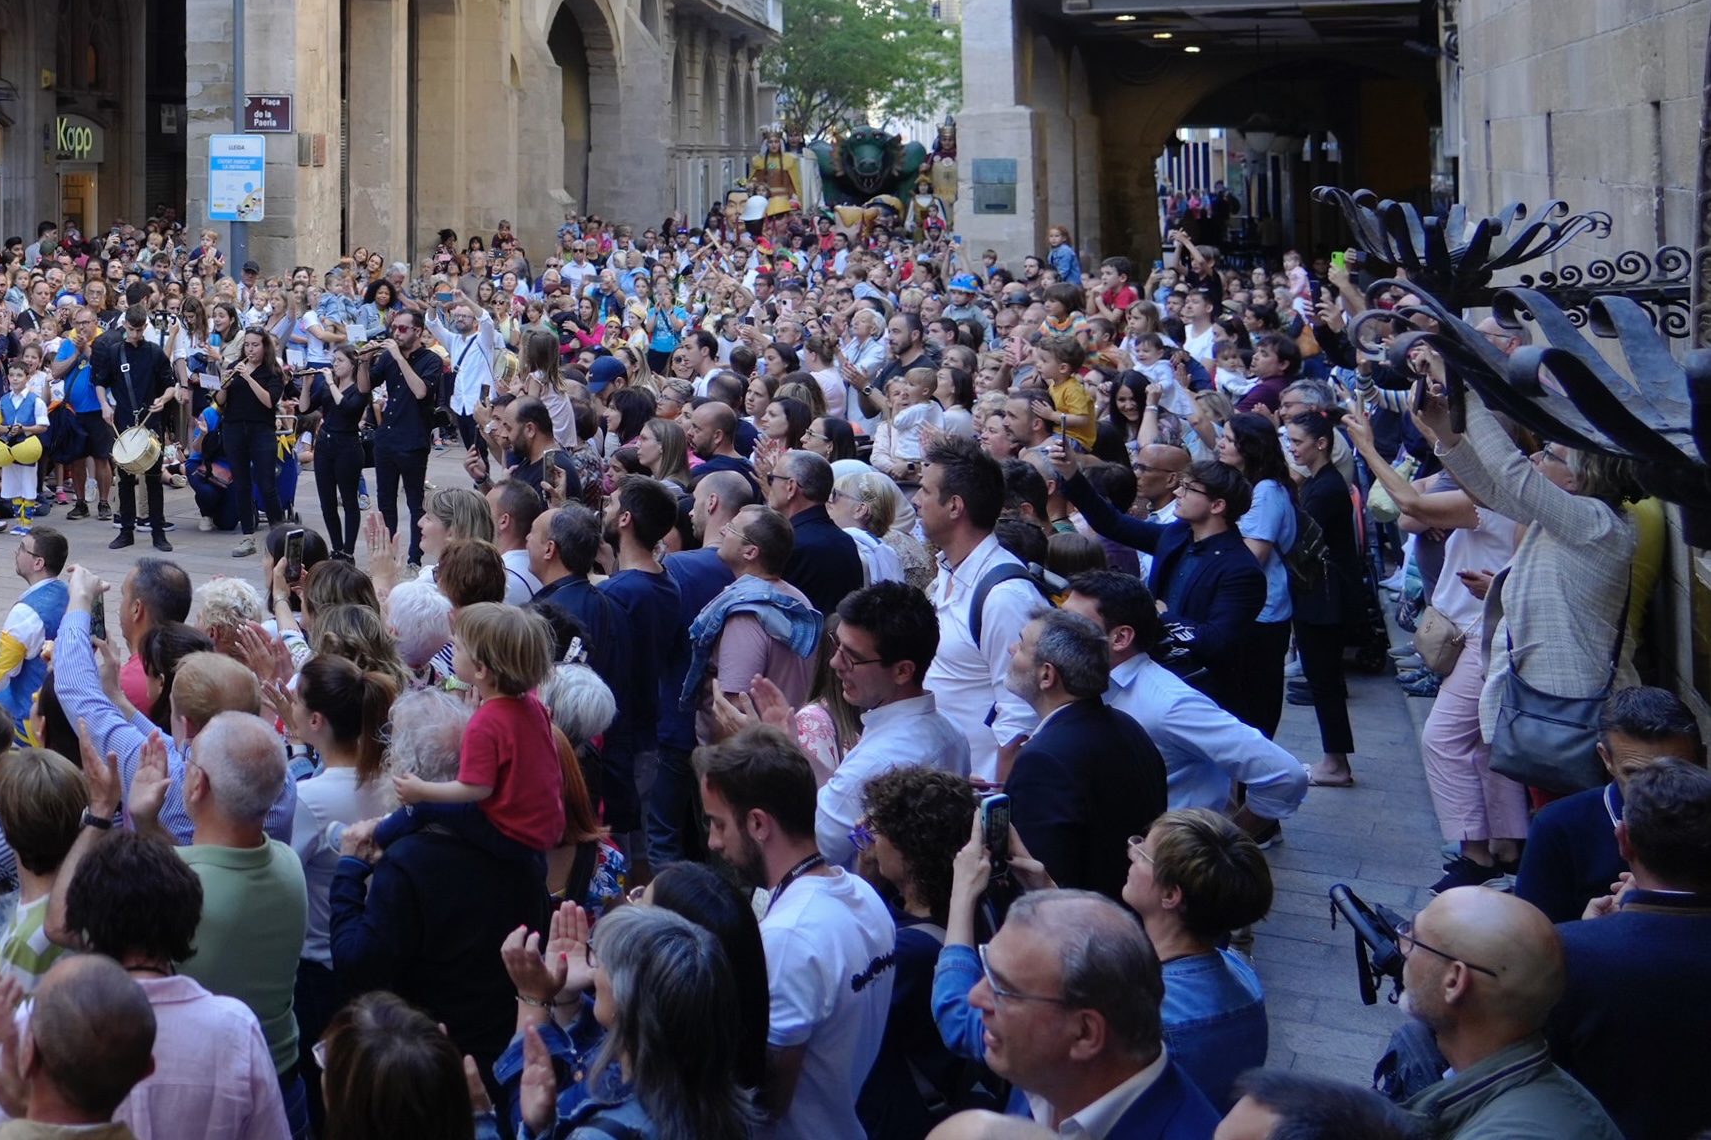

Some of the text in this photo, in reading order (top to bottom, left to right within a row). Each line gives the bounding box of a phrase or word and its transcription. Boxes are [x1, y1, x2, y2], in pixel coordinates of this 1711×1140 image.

[261, 98, 281, 106] Plaça
[254, 110, 272, 118] de la
[254, 118, 277, 127] Paeria
